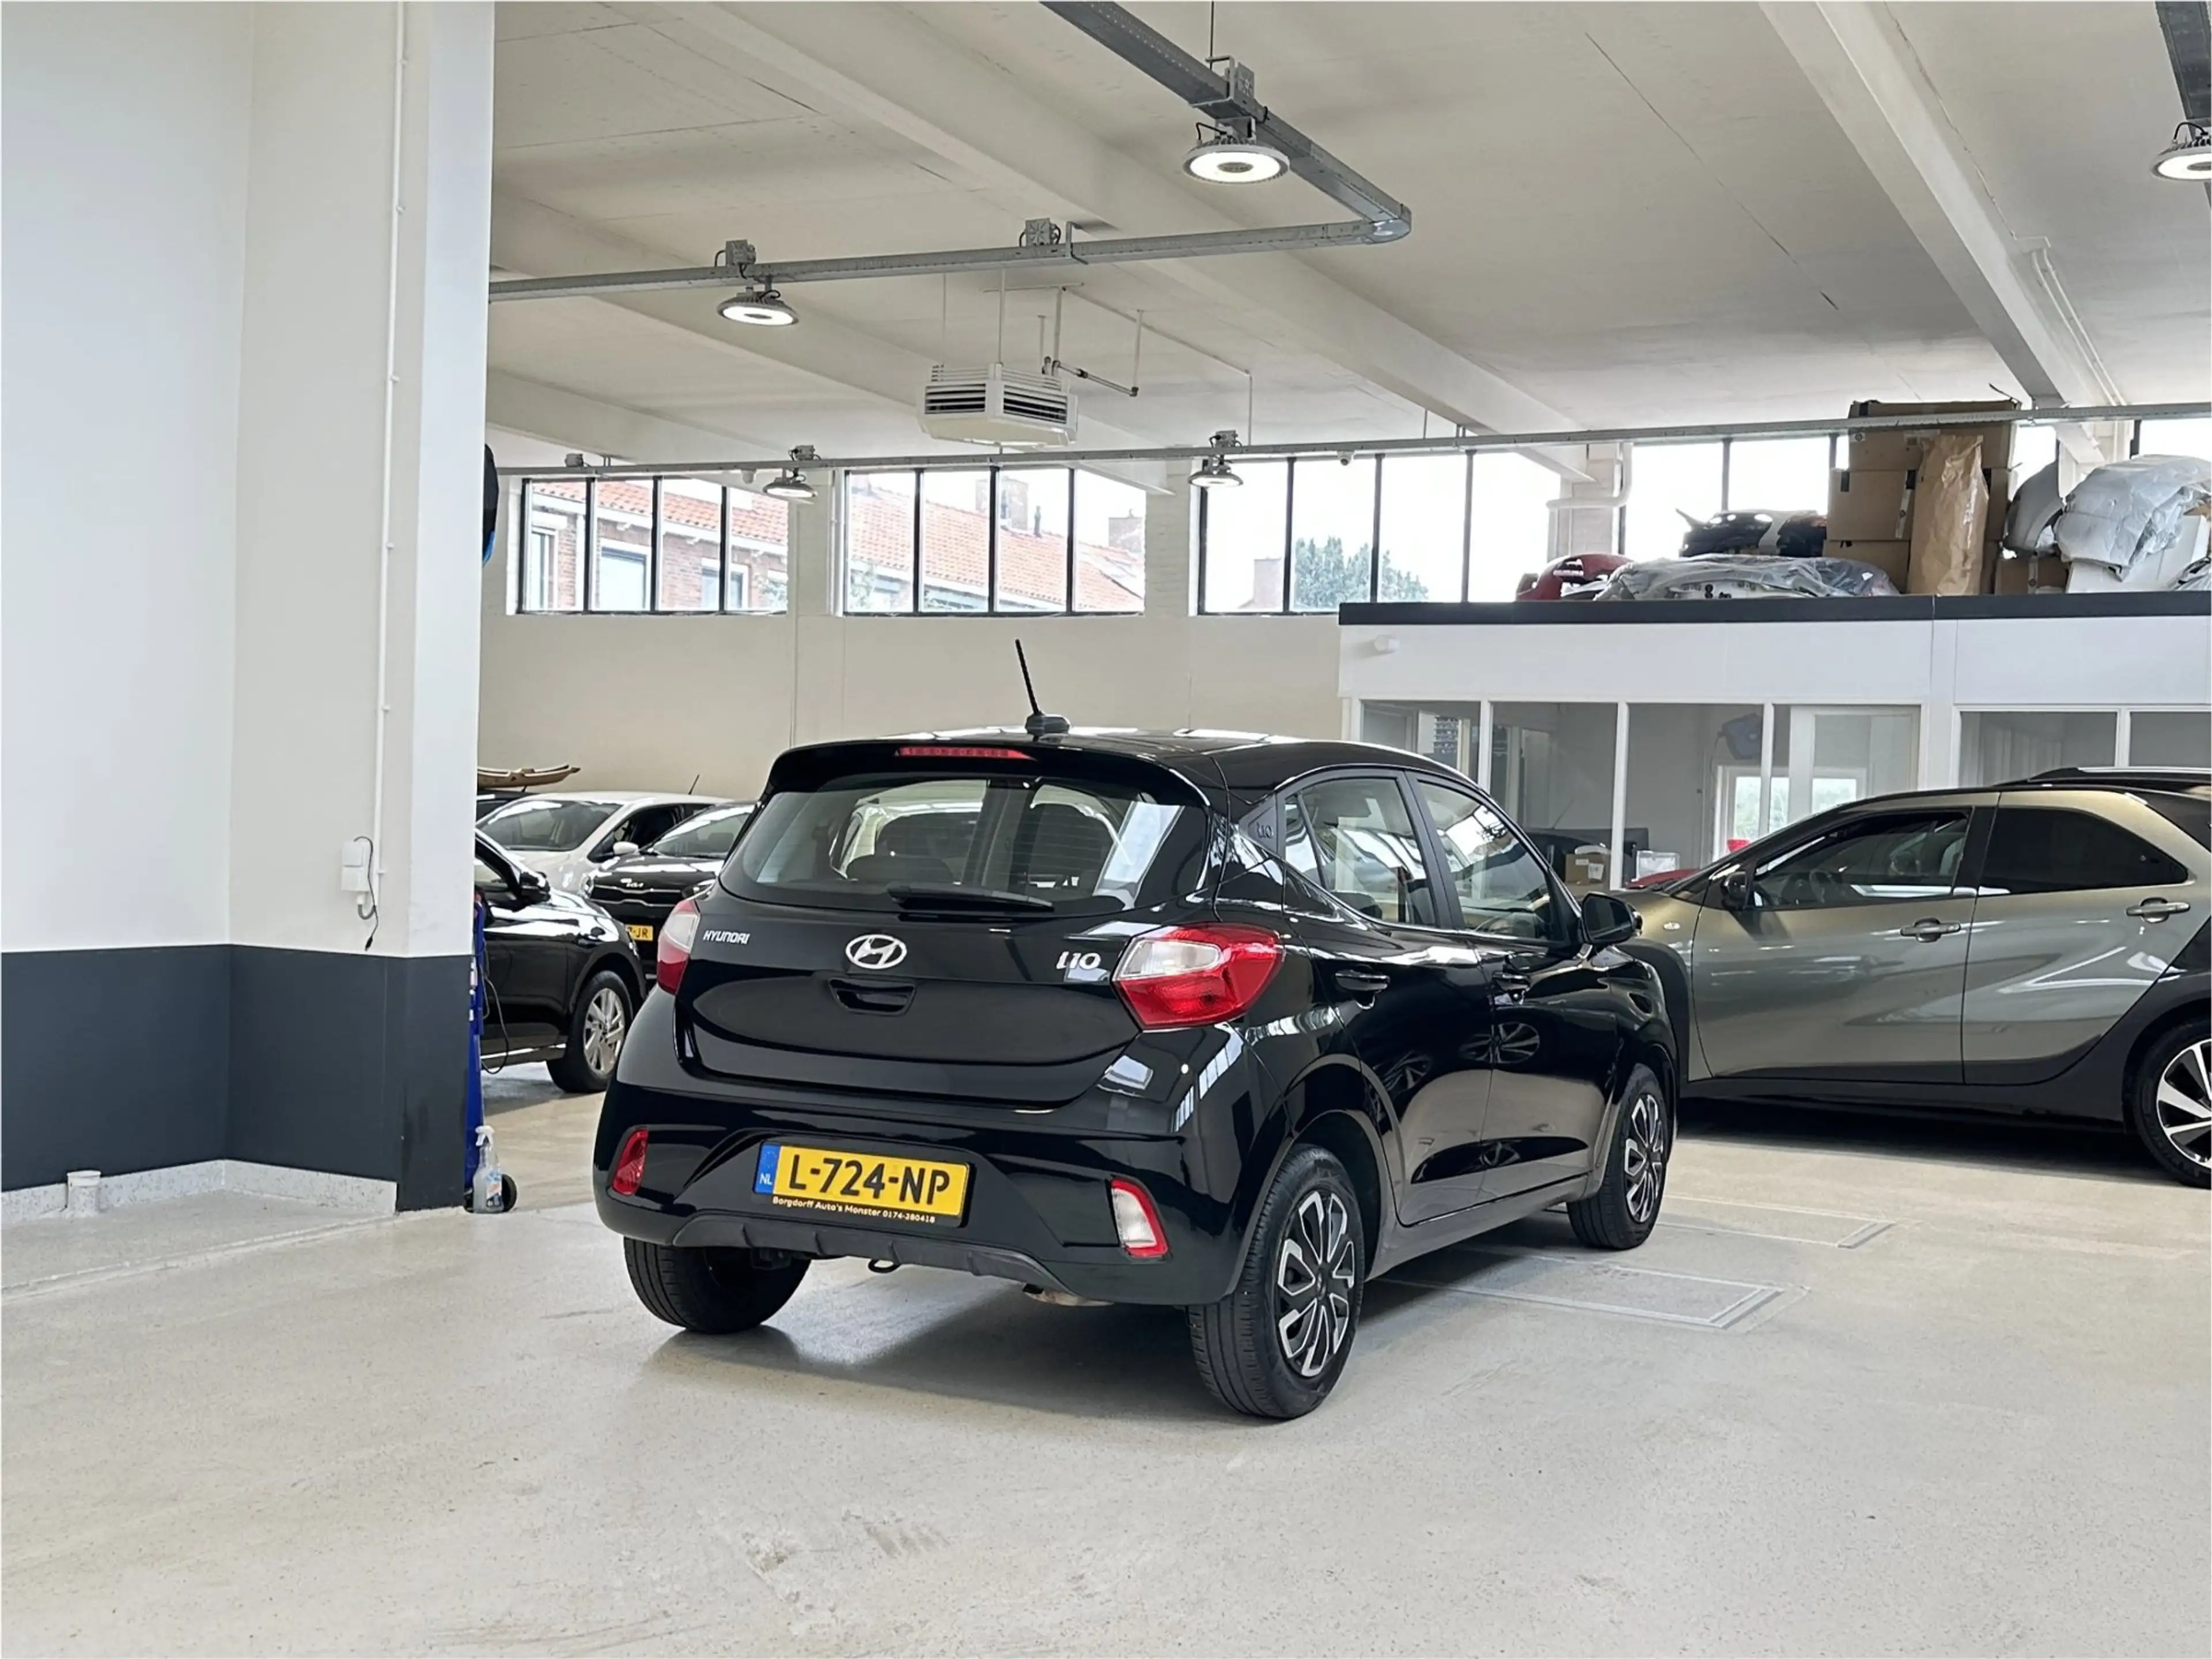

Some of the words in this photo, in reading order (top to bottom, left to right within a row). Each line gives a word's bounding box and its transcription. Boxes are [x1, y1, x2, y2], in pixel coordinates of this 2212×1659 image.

[703, 930, 751, 945] HYUNDAI
[760, 1173, 772, 1185] NL
[789, 1154, 950, 1205] L-724-NP
[772, 1196, 813, 1207] Borgdorff
[816, 1201, 843, 1212] Auto's
[844, 1205, 881, 1217] Monster
